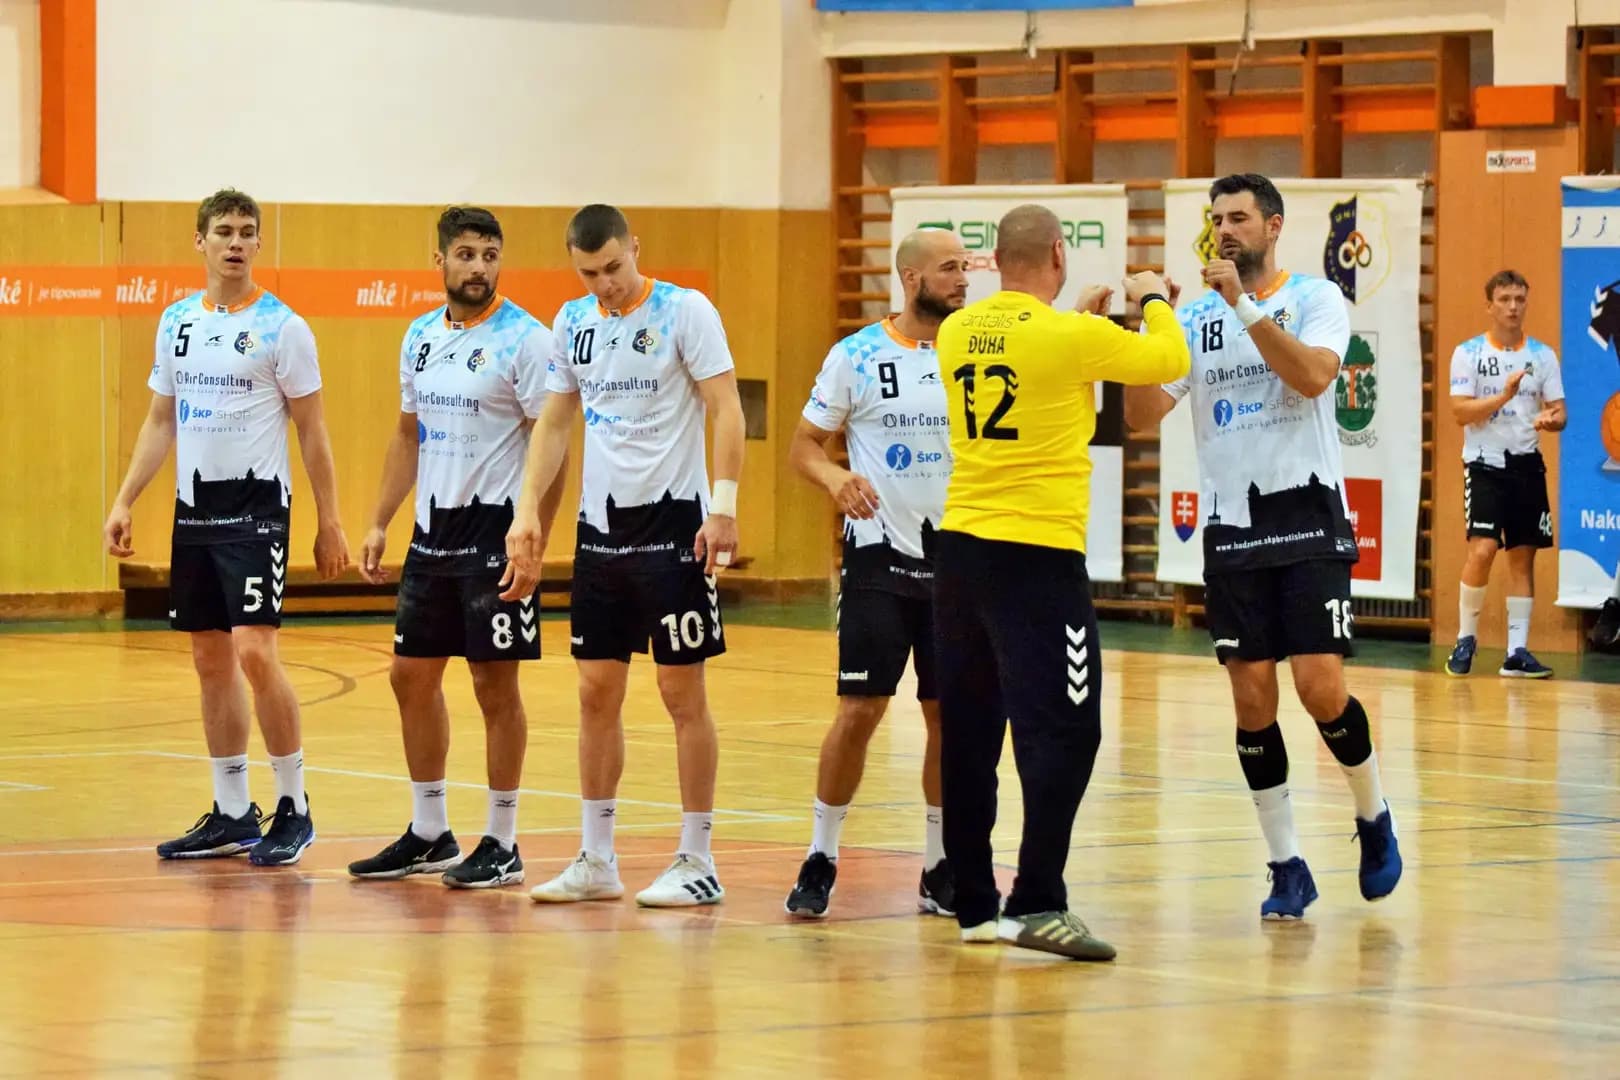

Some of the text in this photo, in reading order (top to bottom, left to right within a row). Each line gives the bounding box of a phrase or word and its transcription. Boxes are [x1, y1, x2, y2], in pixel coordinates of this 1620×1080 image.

[175, 323, 193, 357] 5
[573, 328, 595, 365] 10
[1201, 319, 1224, 353] 18
[415, 343, 431, 372] 8
[1477, 357, 1500, 377] 48
[184, 371, 253, 391] AirConsulting
[878, 362, 899, 399] 9
[192, 406, 213, 419] ŠKP
[953, 363, 1019, 440] 12
[1238, 402, 1263, 416] ŠKP
[430, 428, 447, 441] ŠKP
[917, 450, 942, 463] ŠKP
[243, 577, 263, 612] 5
[491, 612, 514, 649] 8
[661, 611, 705, 652] 10
[1324, 599, 1354, 640] 18
